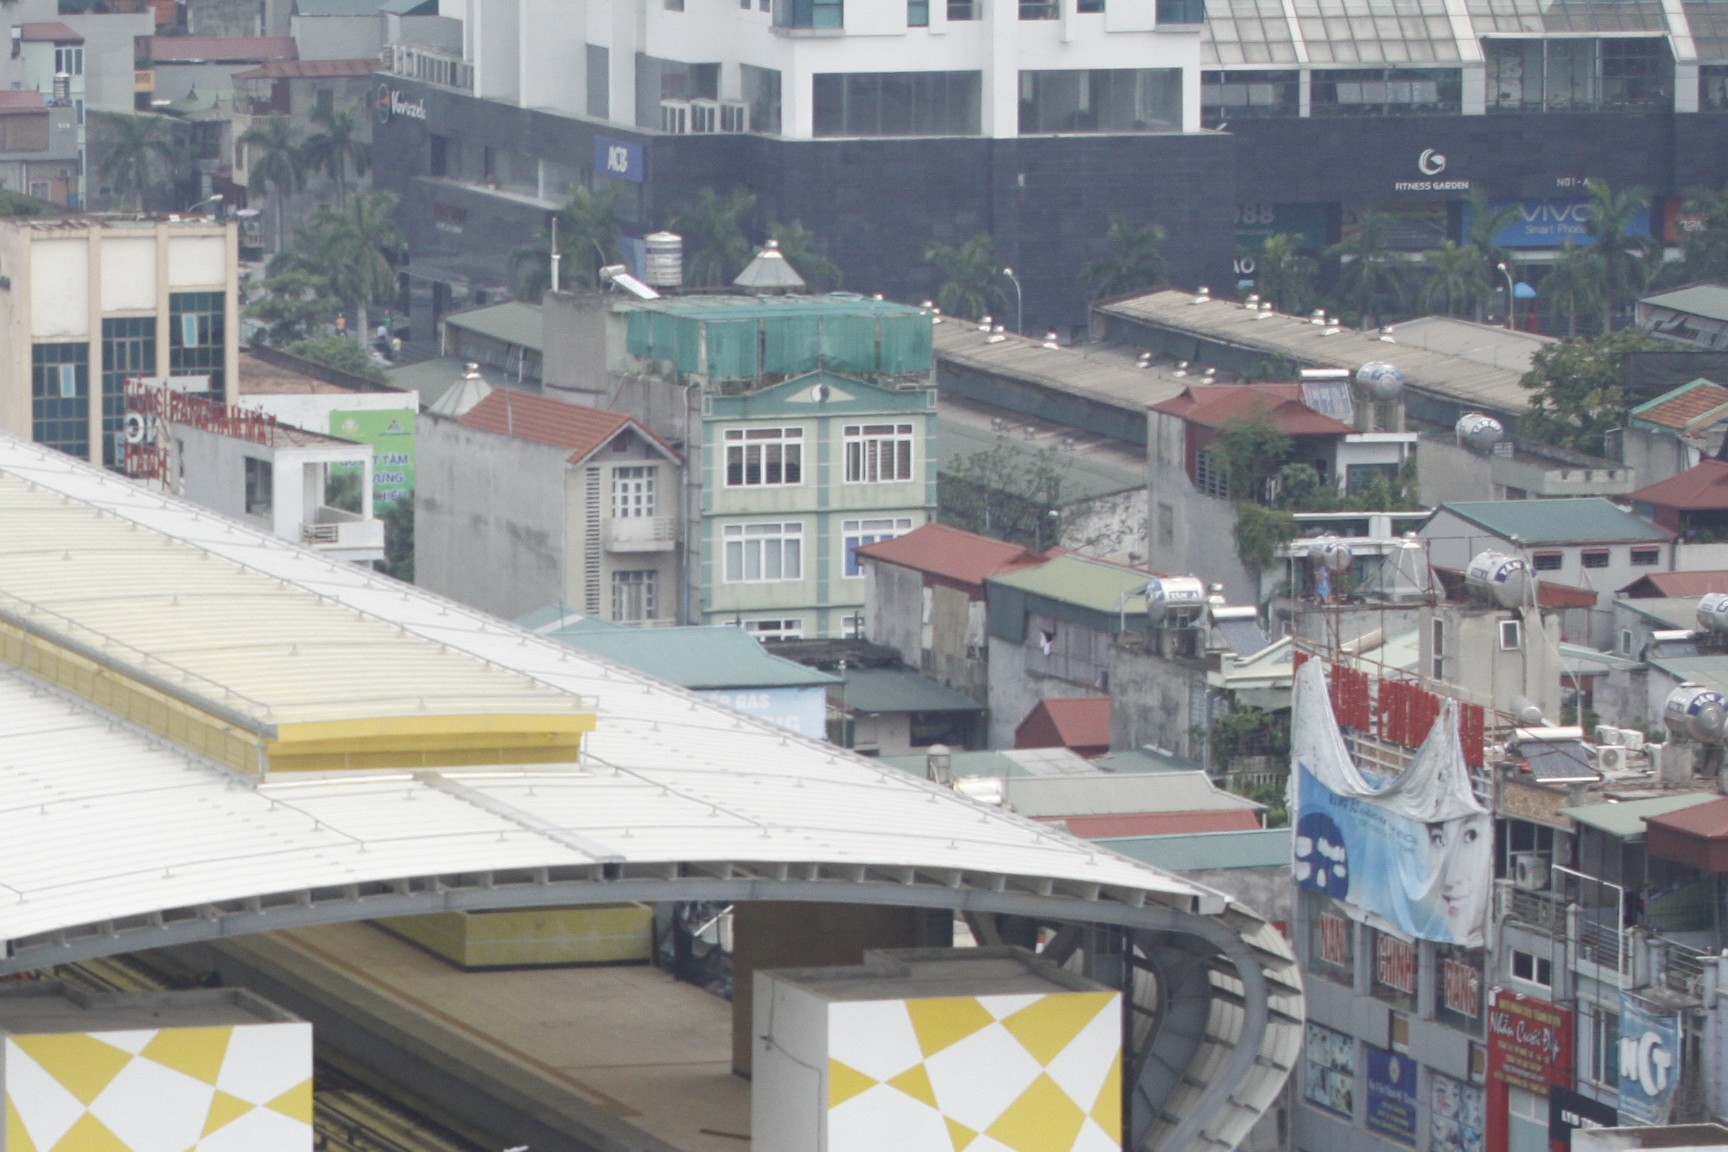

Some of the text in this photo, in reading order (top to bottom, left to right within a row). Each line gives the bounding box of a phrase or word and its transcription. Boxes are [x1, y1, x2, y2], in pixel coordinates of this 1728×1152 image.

[608, 146, 628, 173] ACB
[1395, 181, 1470, 190] FITNESS GARDEN
[736, 693, 770, 709] GAS
